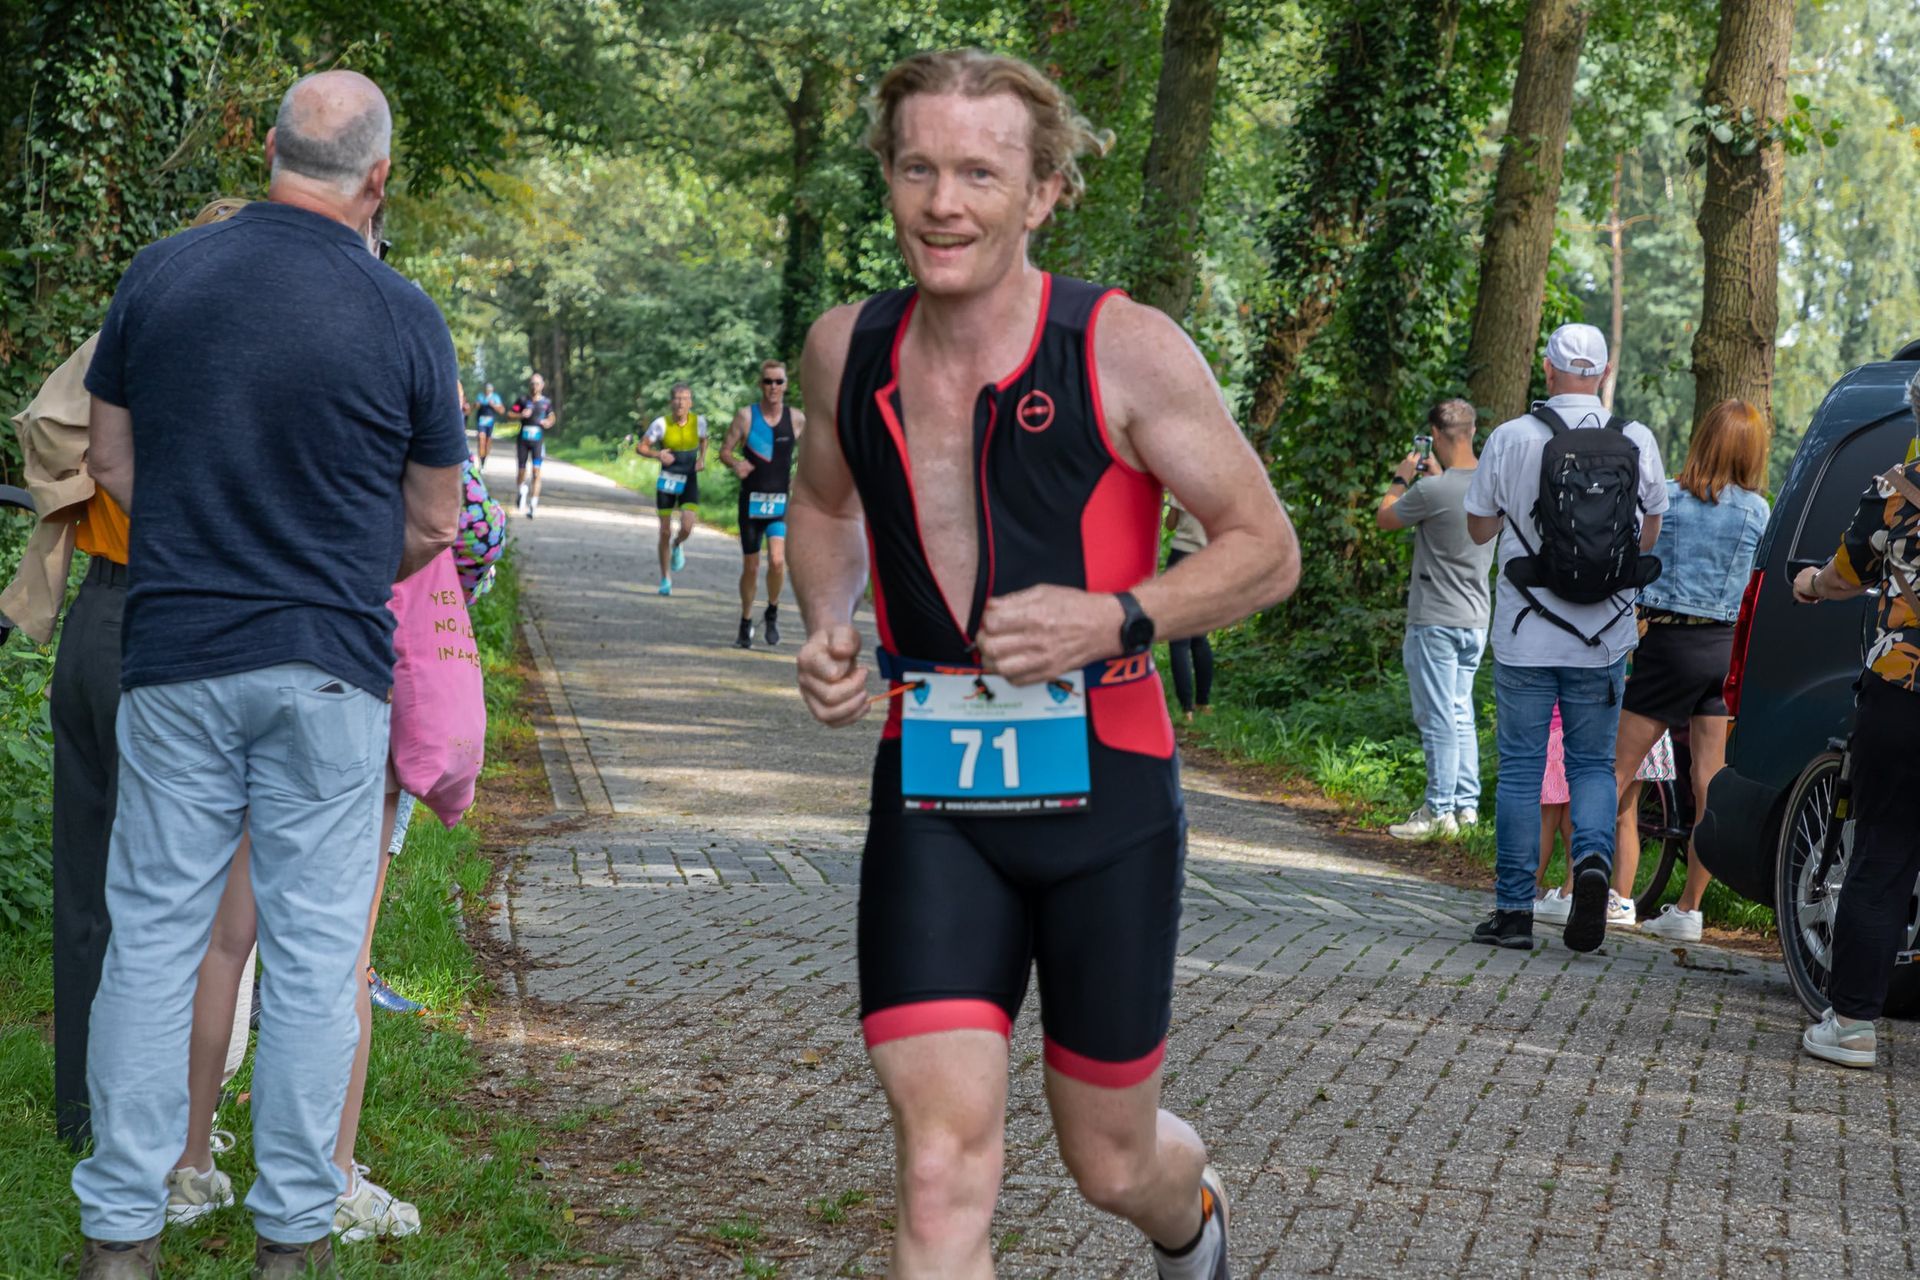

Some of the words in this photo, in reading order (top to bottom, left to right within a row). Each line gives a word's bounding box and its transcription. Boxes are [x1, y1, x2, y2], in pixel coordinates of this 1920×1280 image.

[760, 502, 775, 514] 42
[430, 591, 456, 606] YES
[434, 618, 456, 633] NO
[438, 646, 454, 660] IN
[950, 727, 1020, 789] 71
